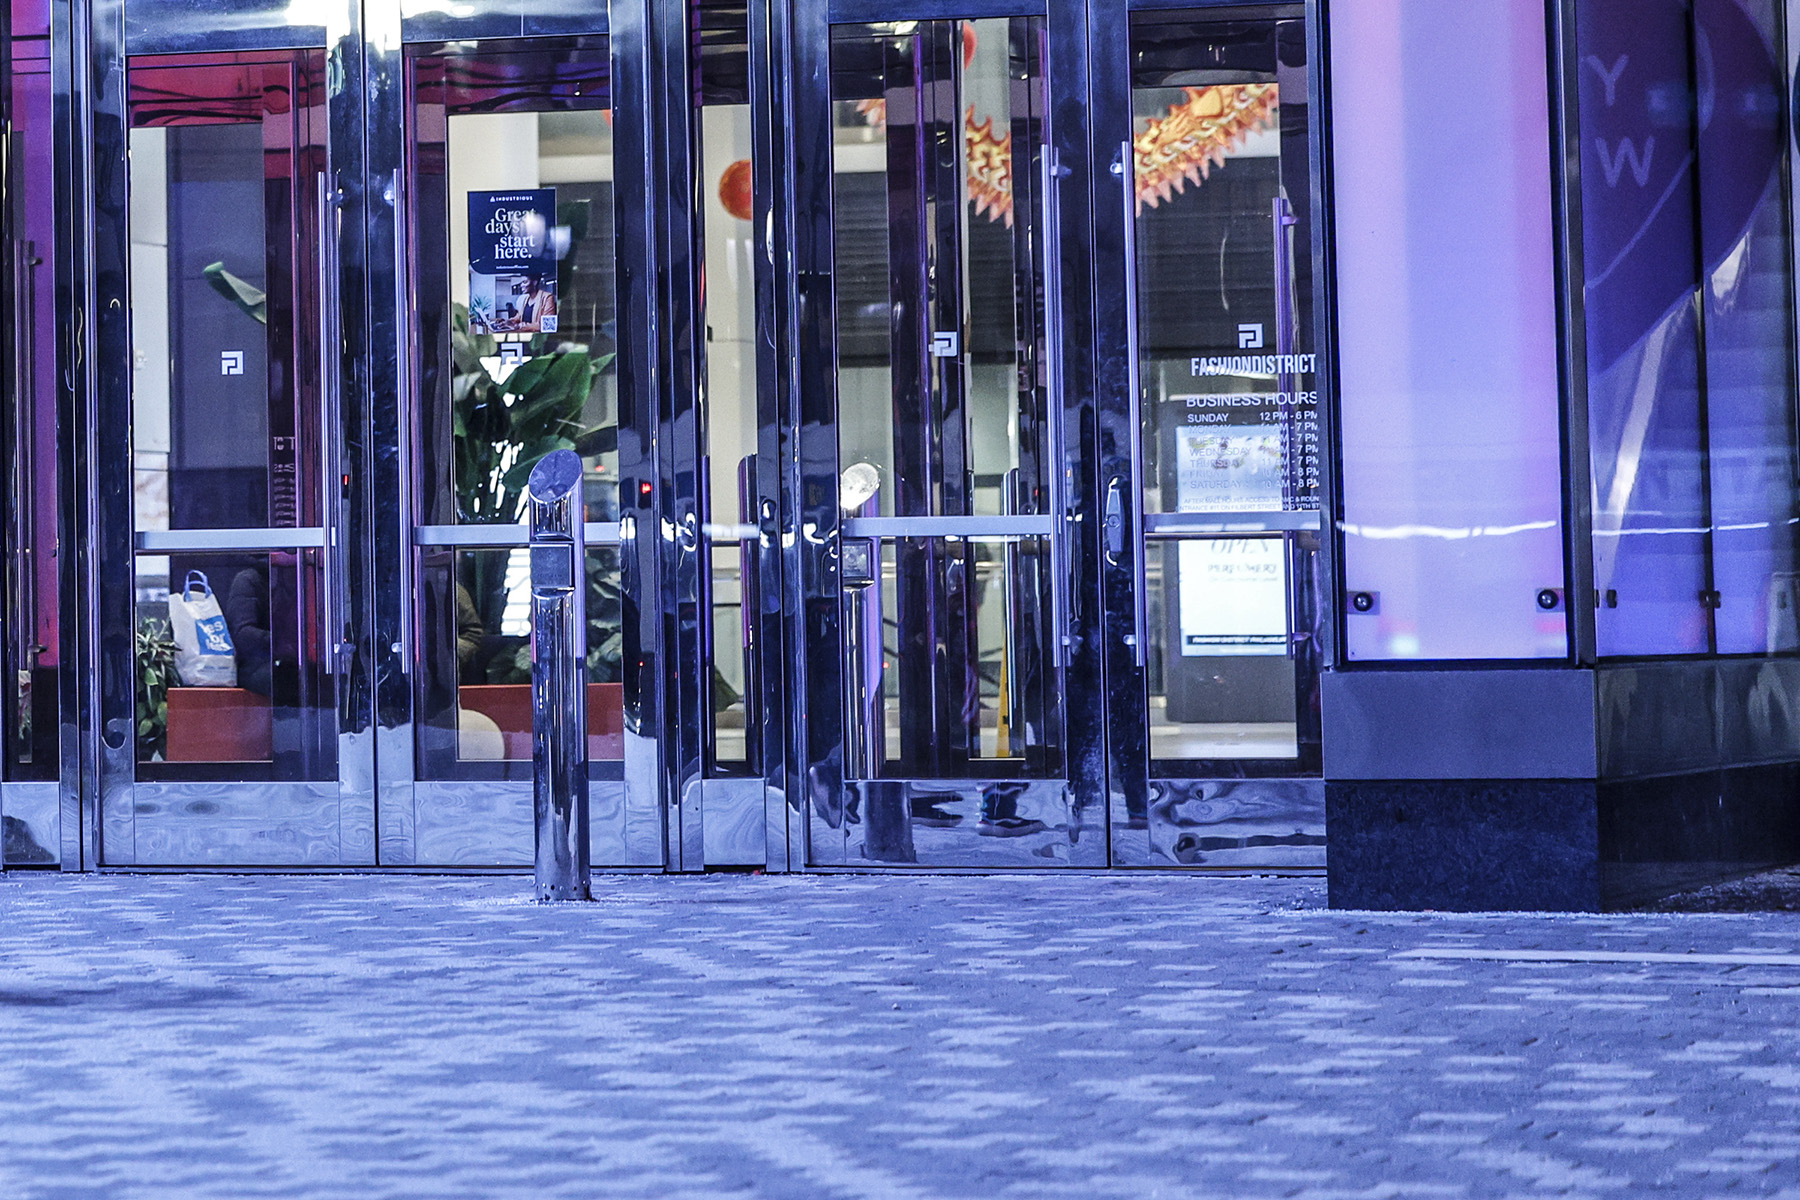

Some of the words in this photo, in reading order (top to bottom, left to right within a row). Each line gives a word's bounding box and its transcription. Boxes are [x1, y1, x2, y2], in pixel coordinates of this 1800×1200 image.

[494, 207, 537, 223] Great
[485, 218, 520, 237] days
[499, 234, 536, 249] start
[494, 244, 533, 260] here.
[1186, 394, 1261, 408] BUSINESS
[1265, 391, 1318, 406] HOURS
[1187, 413, 1229, 423] SUNDAY
[1260, 412, 1271, 421] 12
[1272, 411, 1288, 420] PM
[1295, 410, 1302, 419] 6
[1188, 424, 1231, 434] MONDAY
[1296, 422, 1302, 431] 7
[1296, 433, 1303, 442] 7
[1189, 447, 1251, 457] WEDNESDAY
[1297, 445, 1303, 453] 7
[1297, 456, 1303, 465] 7
[1297, 467, 1304, 476] 8
[1190, 480, 1242, 490] SATURDAY
[1298, 478, 1304, 487] 8
